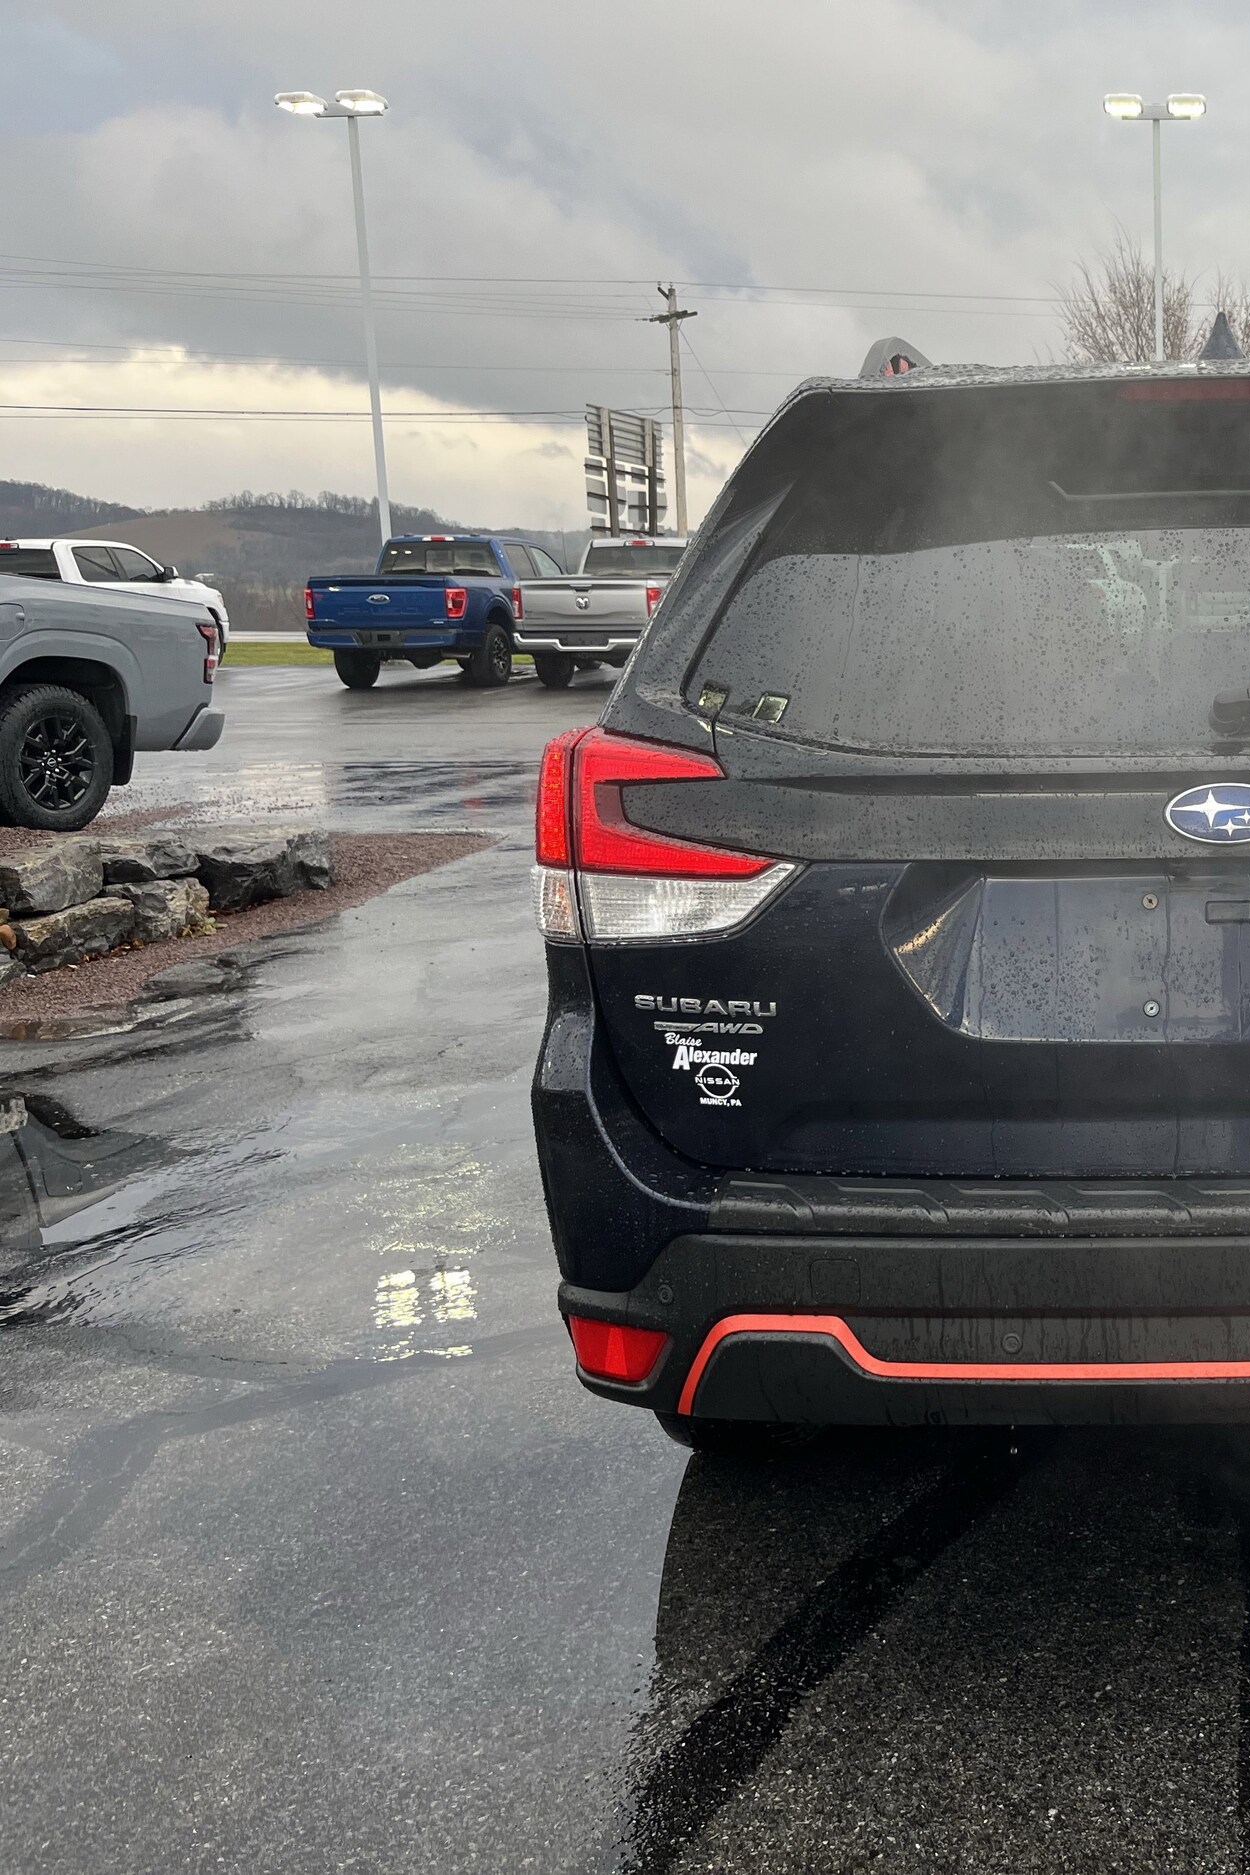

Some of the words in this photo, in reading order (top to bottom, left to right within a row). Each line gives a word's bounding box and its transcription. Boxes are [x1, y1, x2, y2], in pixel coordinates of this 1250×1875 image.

[634, 994, 777, 1017] SUBARU
[693, 1022, 764, 1035] AWD
[664, 1032, 703, 1047] Blaise
[672, 1045, 758, 1070] Alexander
[694, 1076, 740, 1086] NISSAN
[700, 1097, 730, 1107] MUNCY,
[730, 1098, 742, 1106] PA
